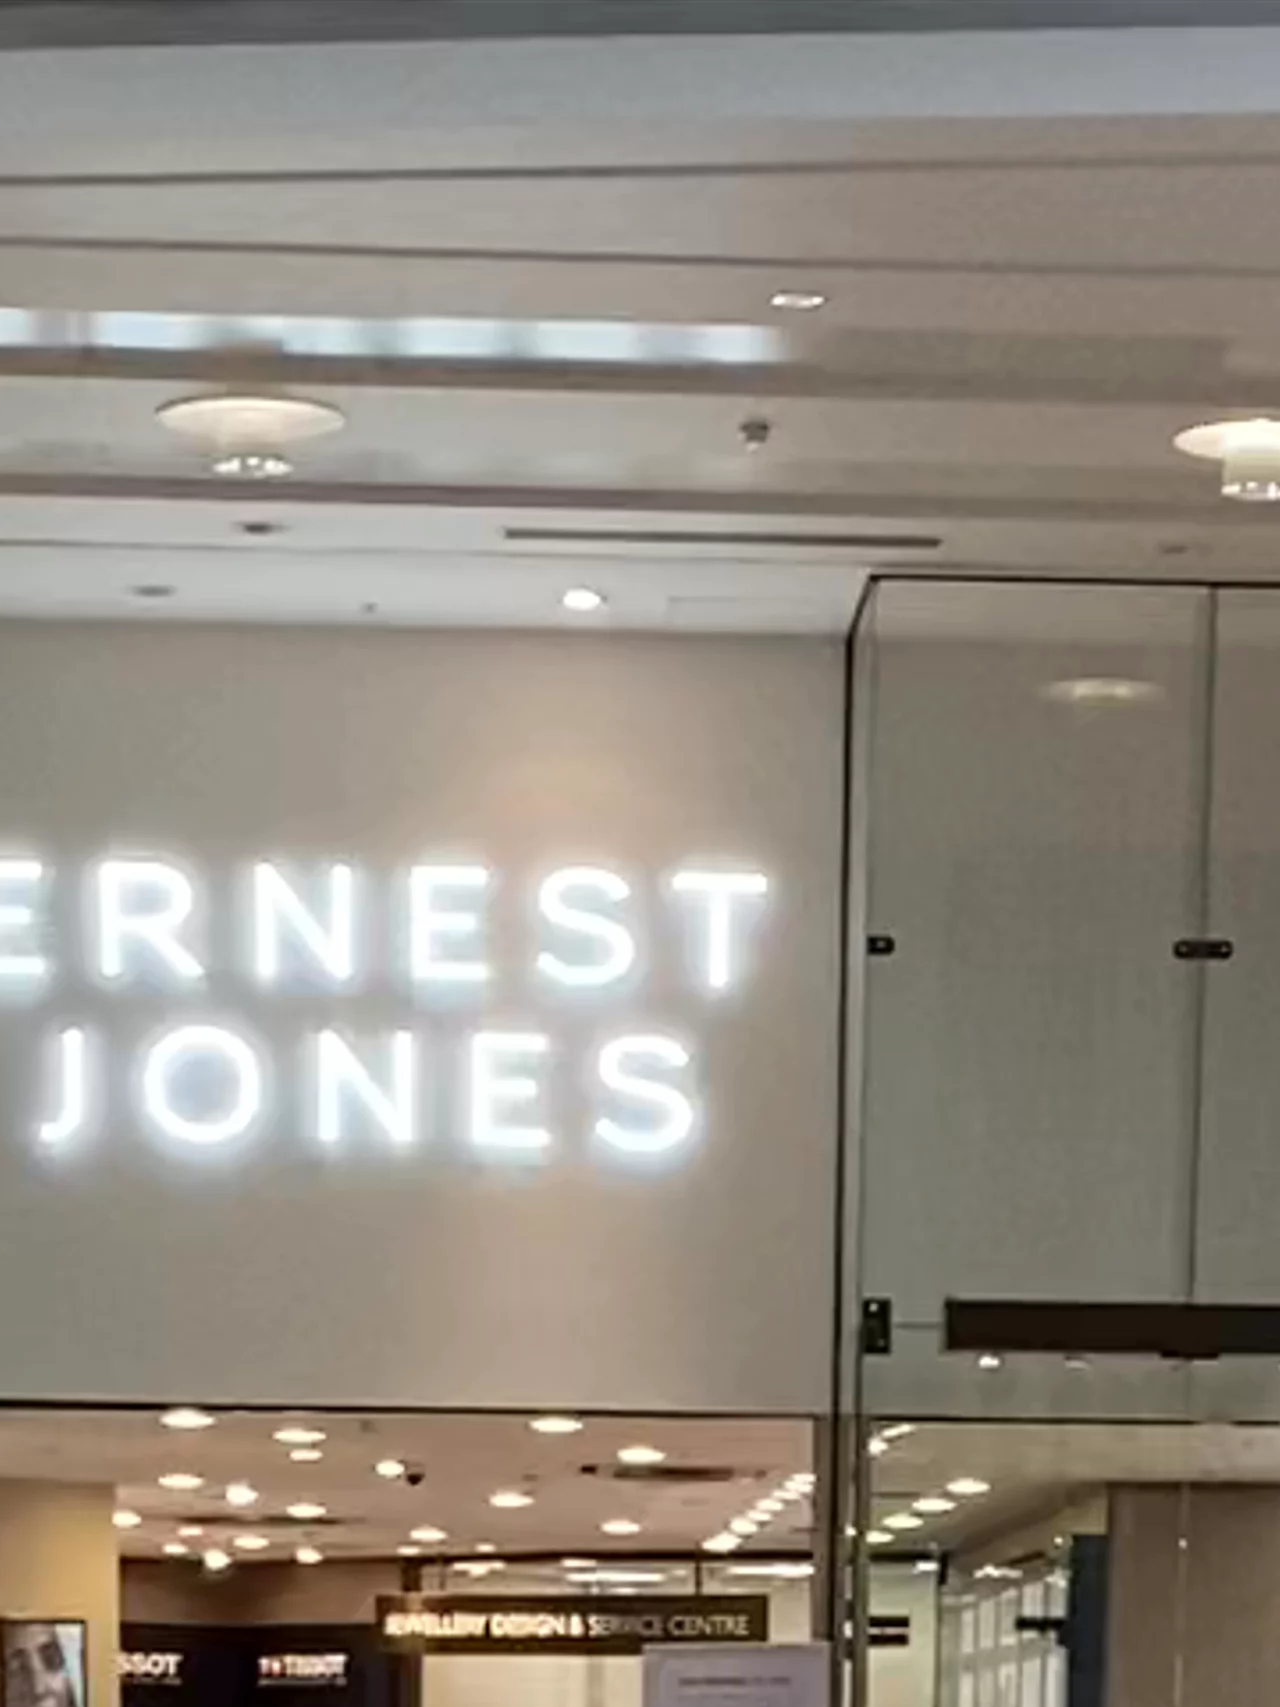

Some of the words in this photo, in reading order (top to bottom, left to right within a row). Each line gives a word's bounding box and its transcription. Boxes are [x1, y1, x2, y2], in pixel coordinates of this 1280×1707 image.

[35, 1022, 698, 1155] JONES
[587, 1613, 664, 1636] SERVICE
[669, 1614, 751, 1637] CENTRE
